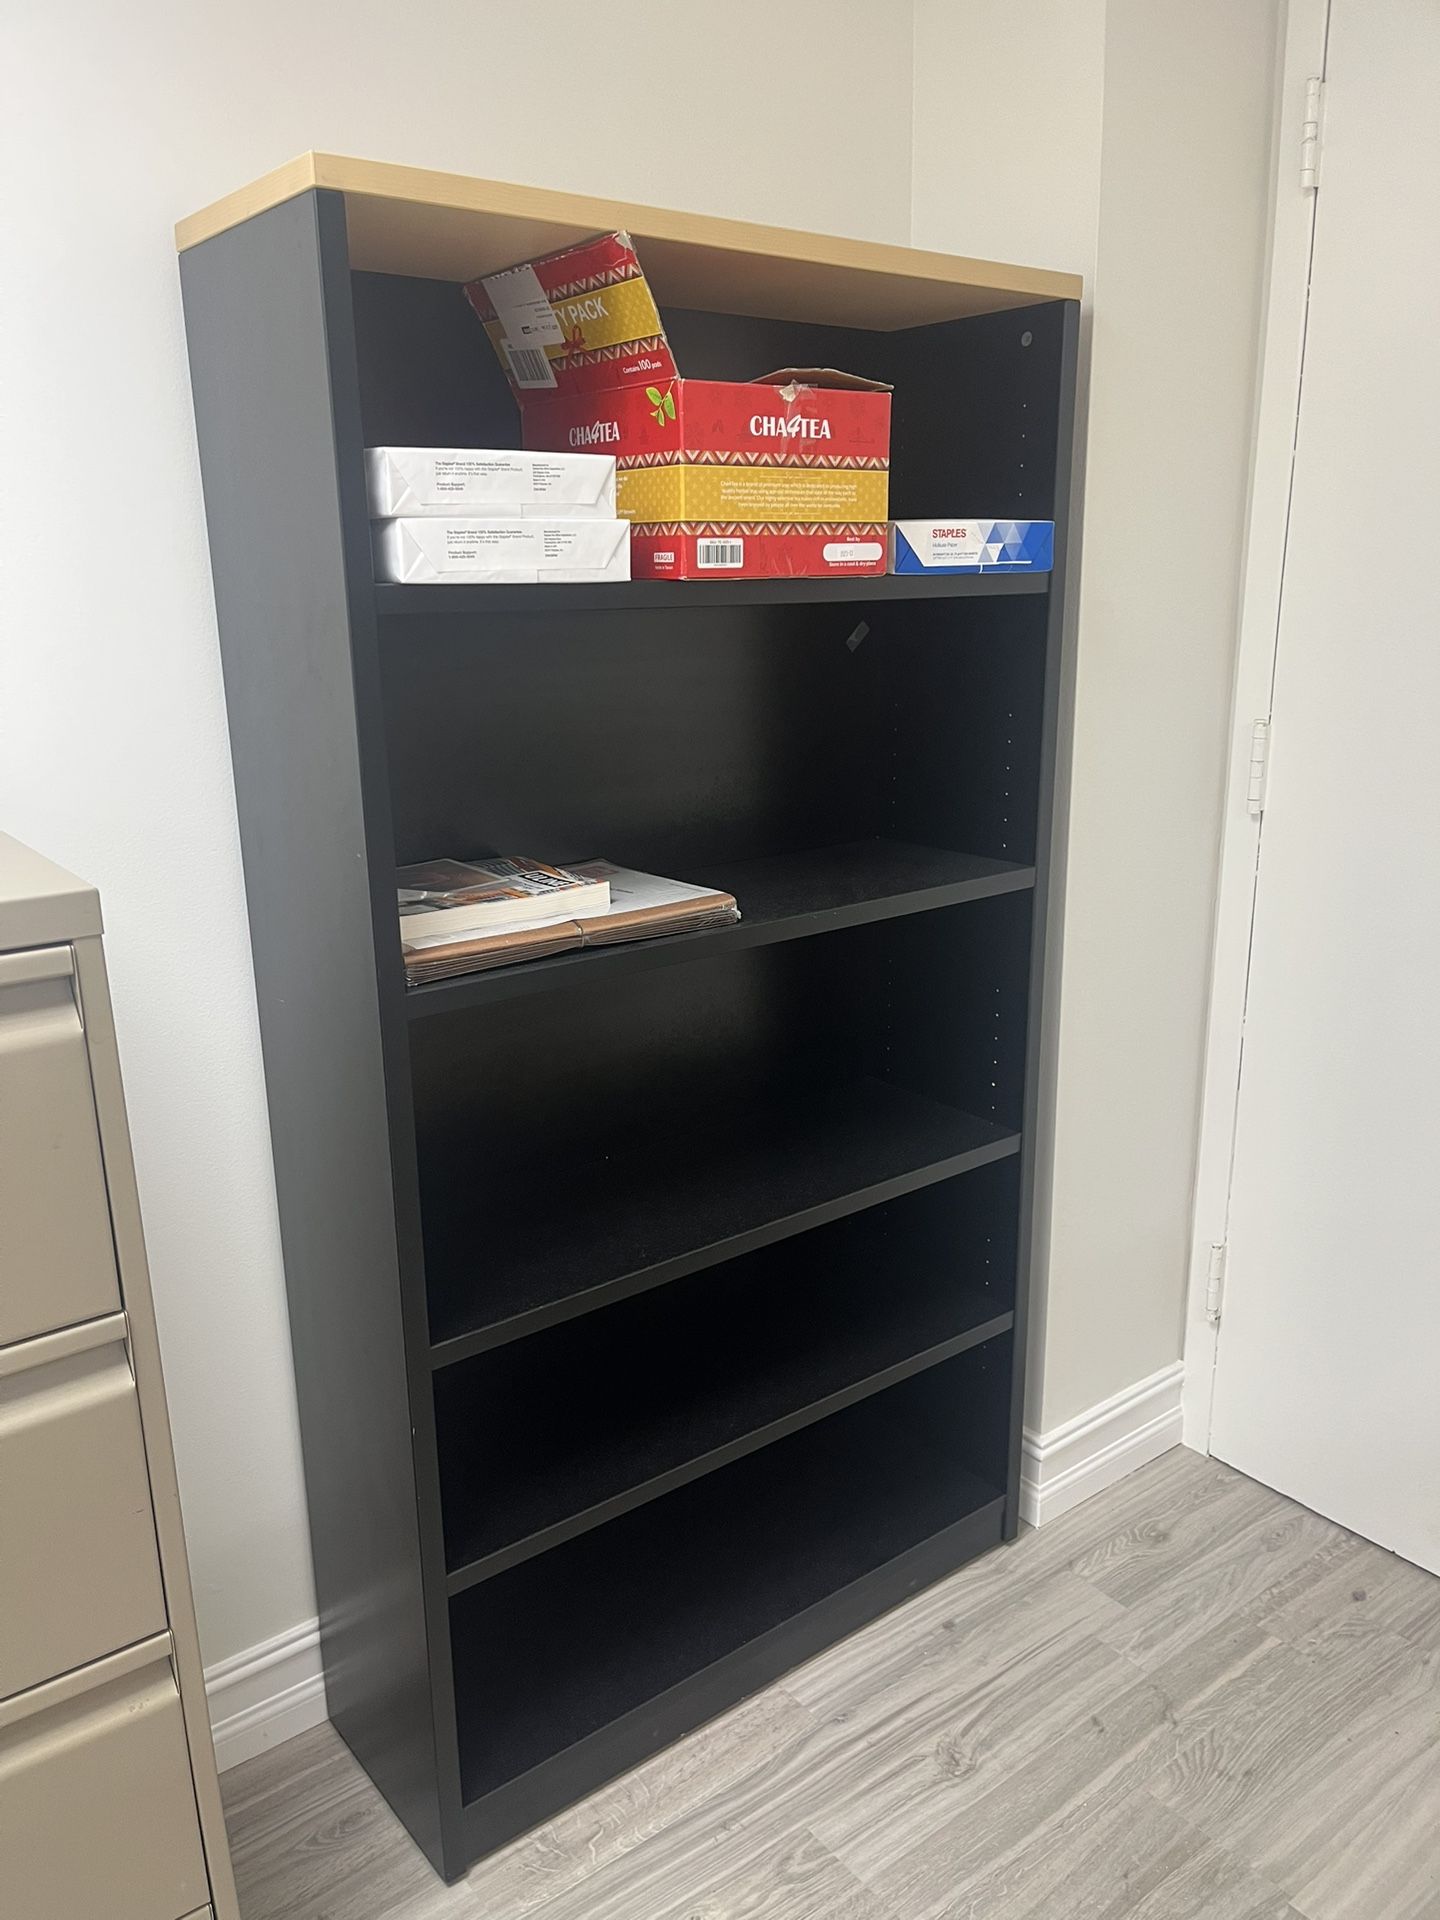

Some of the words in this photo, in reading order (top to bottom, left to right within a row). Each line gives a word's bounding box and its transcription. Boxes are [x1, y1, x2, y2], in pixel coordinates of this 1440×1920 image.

[568, 296, 608, 324] PACK
[638, 359, 651, 370] 100
[932, 528, 967, 538] STAPLES
[654, 553, 673, 561] FRAGILE
